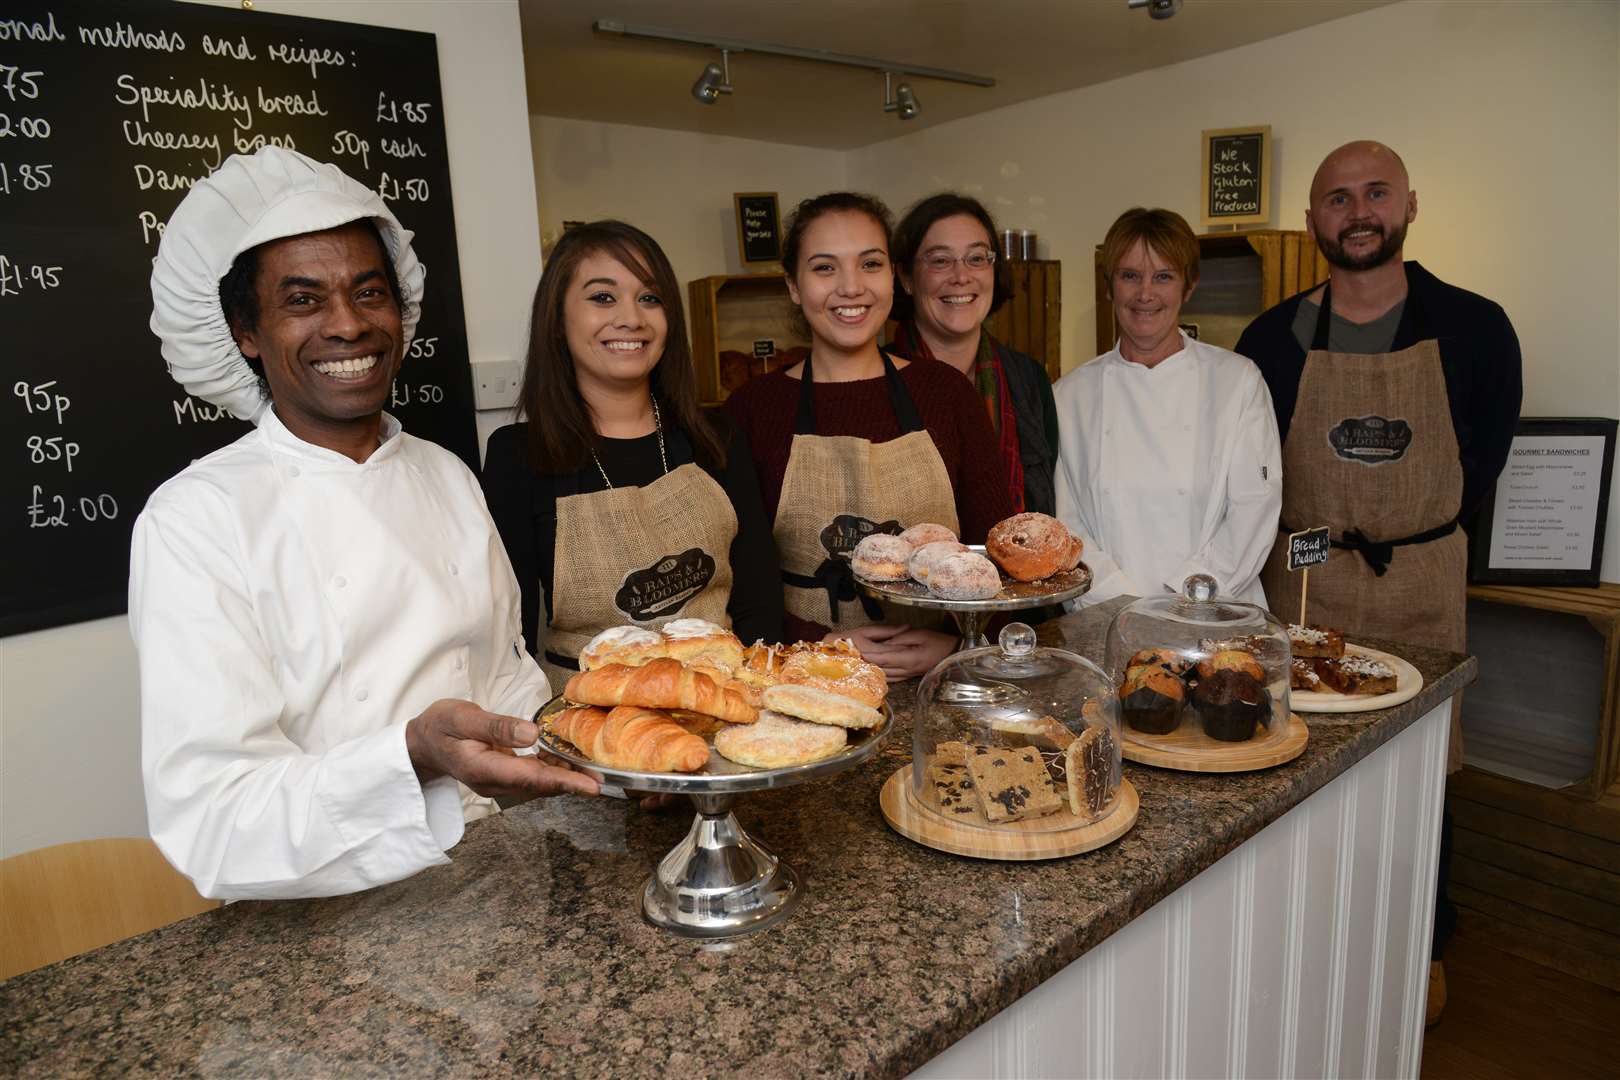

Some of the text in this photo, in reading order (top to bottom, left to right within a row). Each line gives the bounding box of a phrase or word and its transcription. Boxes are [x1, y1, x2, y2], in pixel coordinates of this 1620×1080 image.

[79, 22, 186, 52] methods
[202, 35, 257, 60] and
[115, 74, 328, 130] Speciality bread
[376, 90, 432, 123] £1.85
[123, 119, 222, 170] Cheesey
[331, 130, 427, 170] 50p each
[379, 171, 430, 202] £1.50
[1213, 161, 1252, 174] Stock
[14, 381, 71, 425] 95p
[391, 377, 444, 408] £1.50
[26, 435, 80, 473] 85p
[1512, 448, 1591, 456] GOURMET SANDWICHES
[27, 484, 118, 528] £2.00
[1293, 537, 1320, 553] Bread
[630, 567, 709, 607] BLOOMERS
